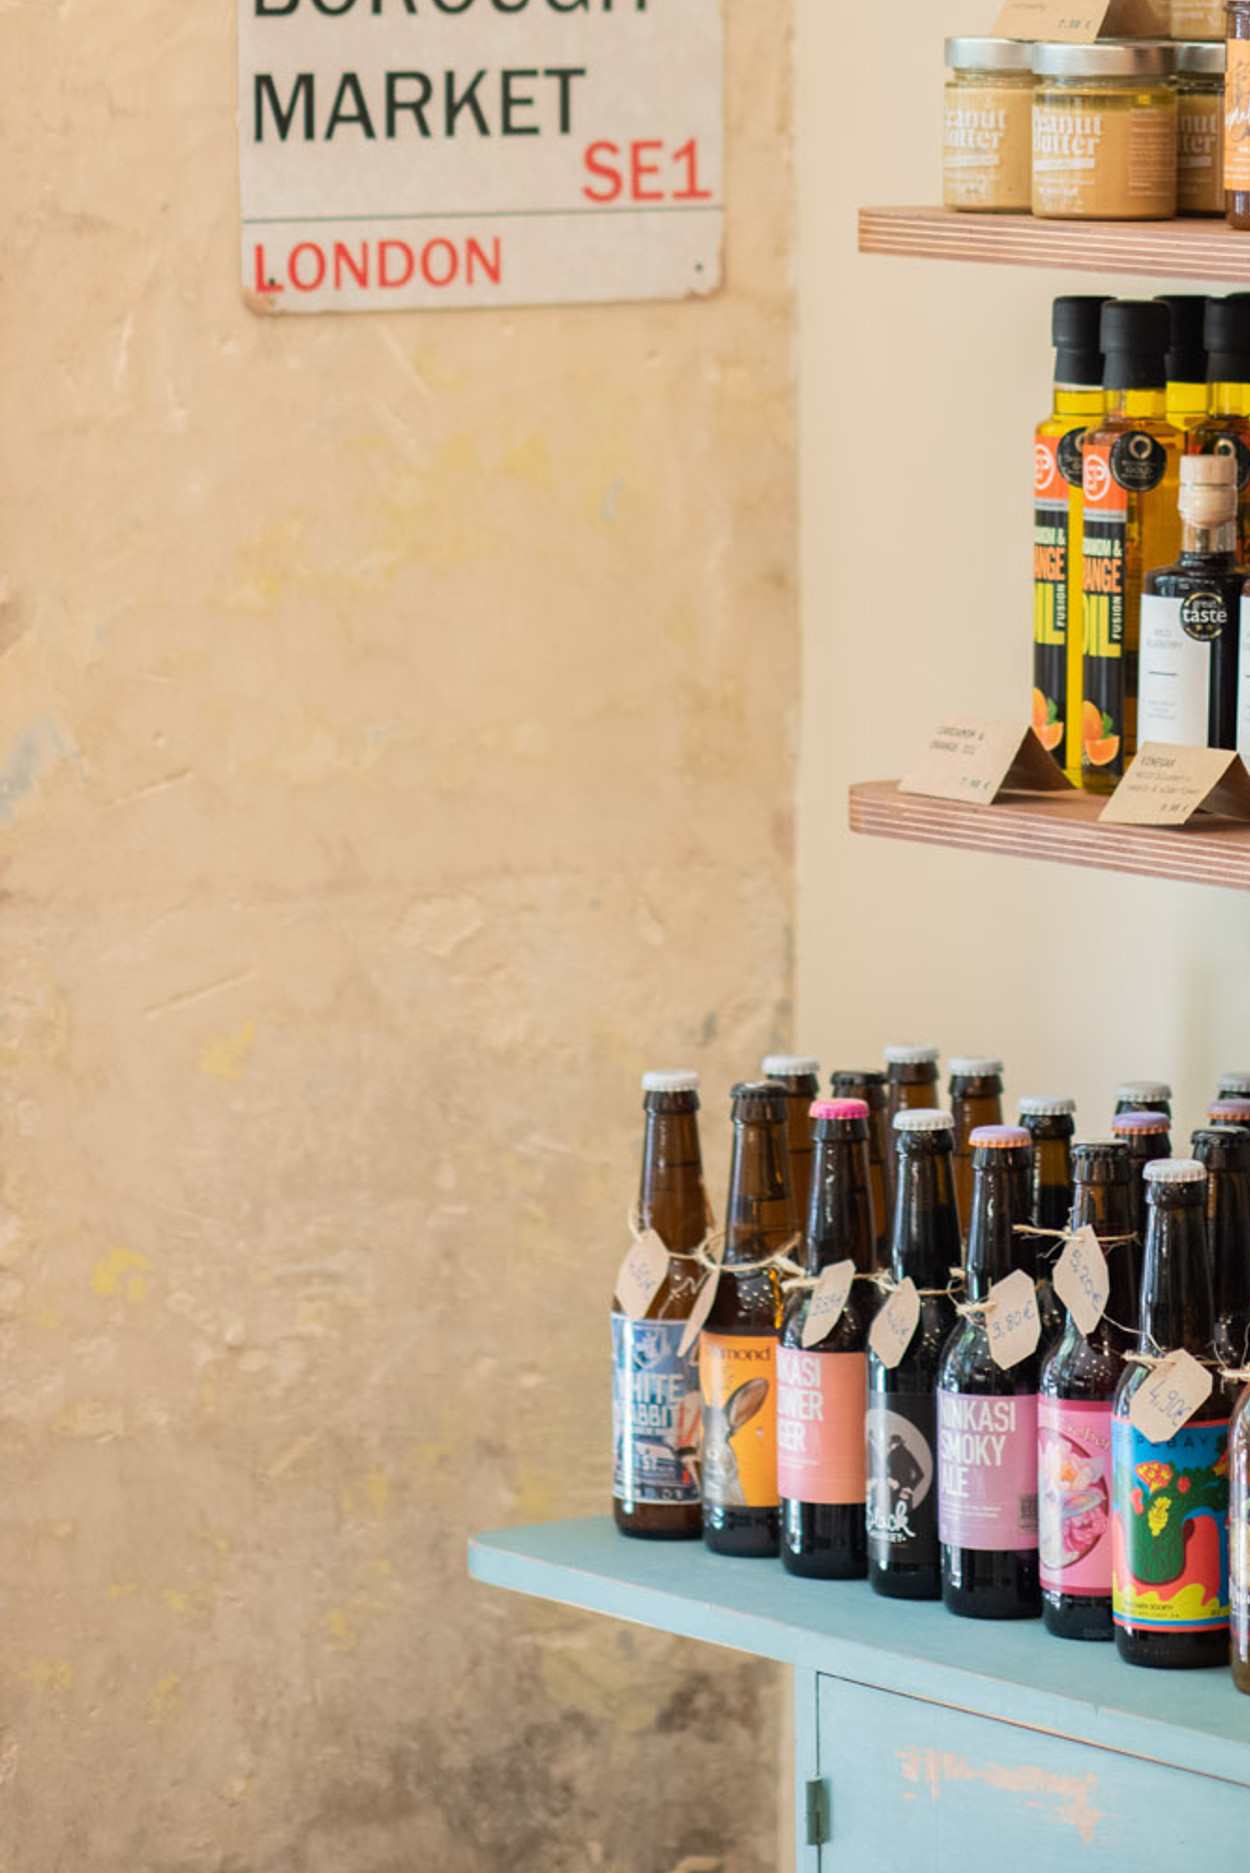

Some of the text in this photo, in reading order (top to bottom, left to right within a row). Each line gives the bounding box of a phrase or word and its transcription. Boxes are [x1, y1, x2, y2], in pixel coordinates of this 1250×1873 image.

[253, 68, 713, 204] MARKET SE1
[254, 237, 502, 295] LONDON
[1057, 529, 1066, 545] &
[1113, 539, 1123, 556] &
[1034, 544, 1065, 582] ANGE
[1034, 582, 1065, 645] IL
[1055, 583, 1066, 628] FUSION
[1111, 595, 1123, 640] FUSION
[1182, 607, 1228, 625] taste
[1191, 599, 1218, 611] great
[629, 1373, 684, 1404] HITE
[940, 1399, 1016, 1433] NINKASI
[940, 1434, 1007, 1467] SMOKY
[941, 1467, 971, 1496] ALE
